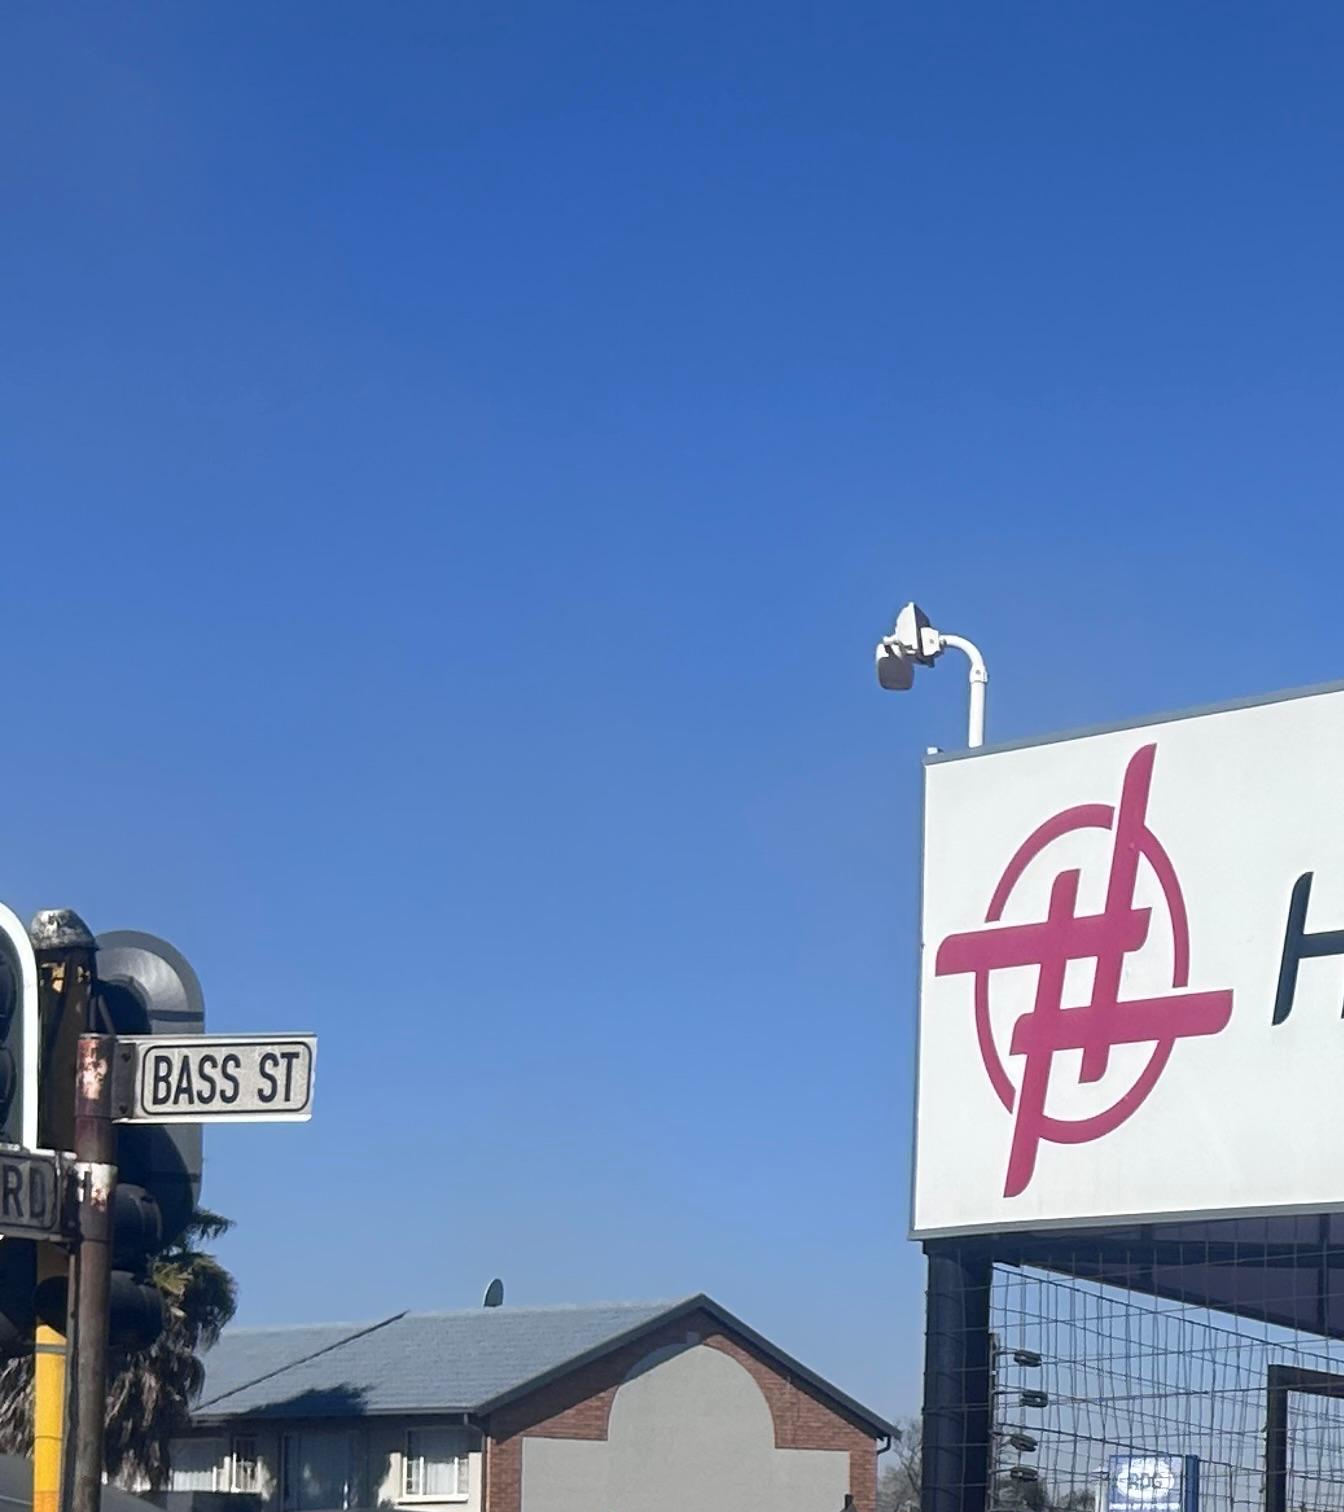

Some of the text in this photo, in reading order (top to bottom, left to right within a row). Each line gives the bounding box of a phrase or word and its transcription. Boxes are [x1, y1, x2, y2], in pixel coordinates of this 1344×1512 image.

[152, 1051, 301, 1105] BASS ST
[2, 1165, 46, 1218] RD
